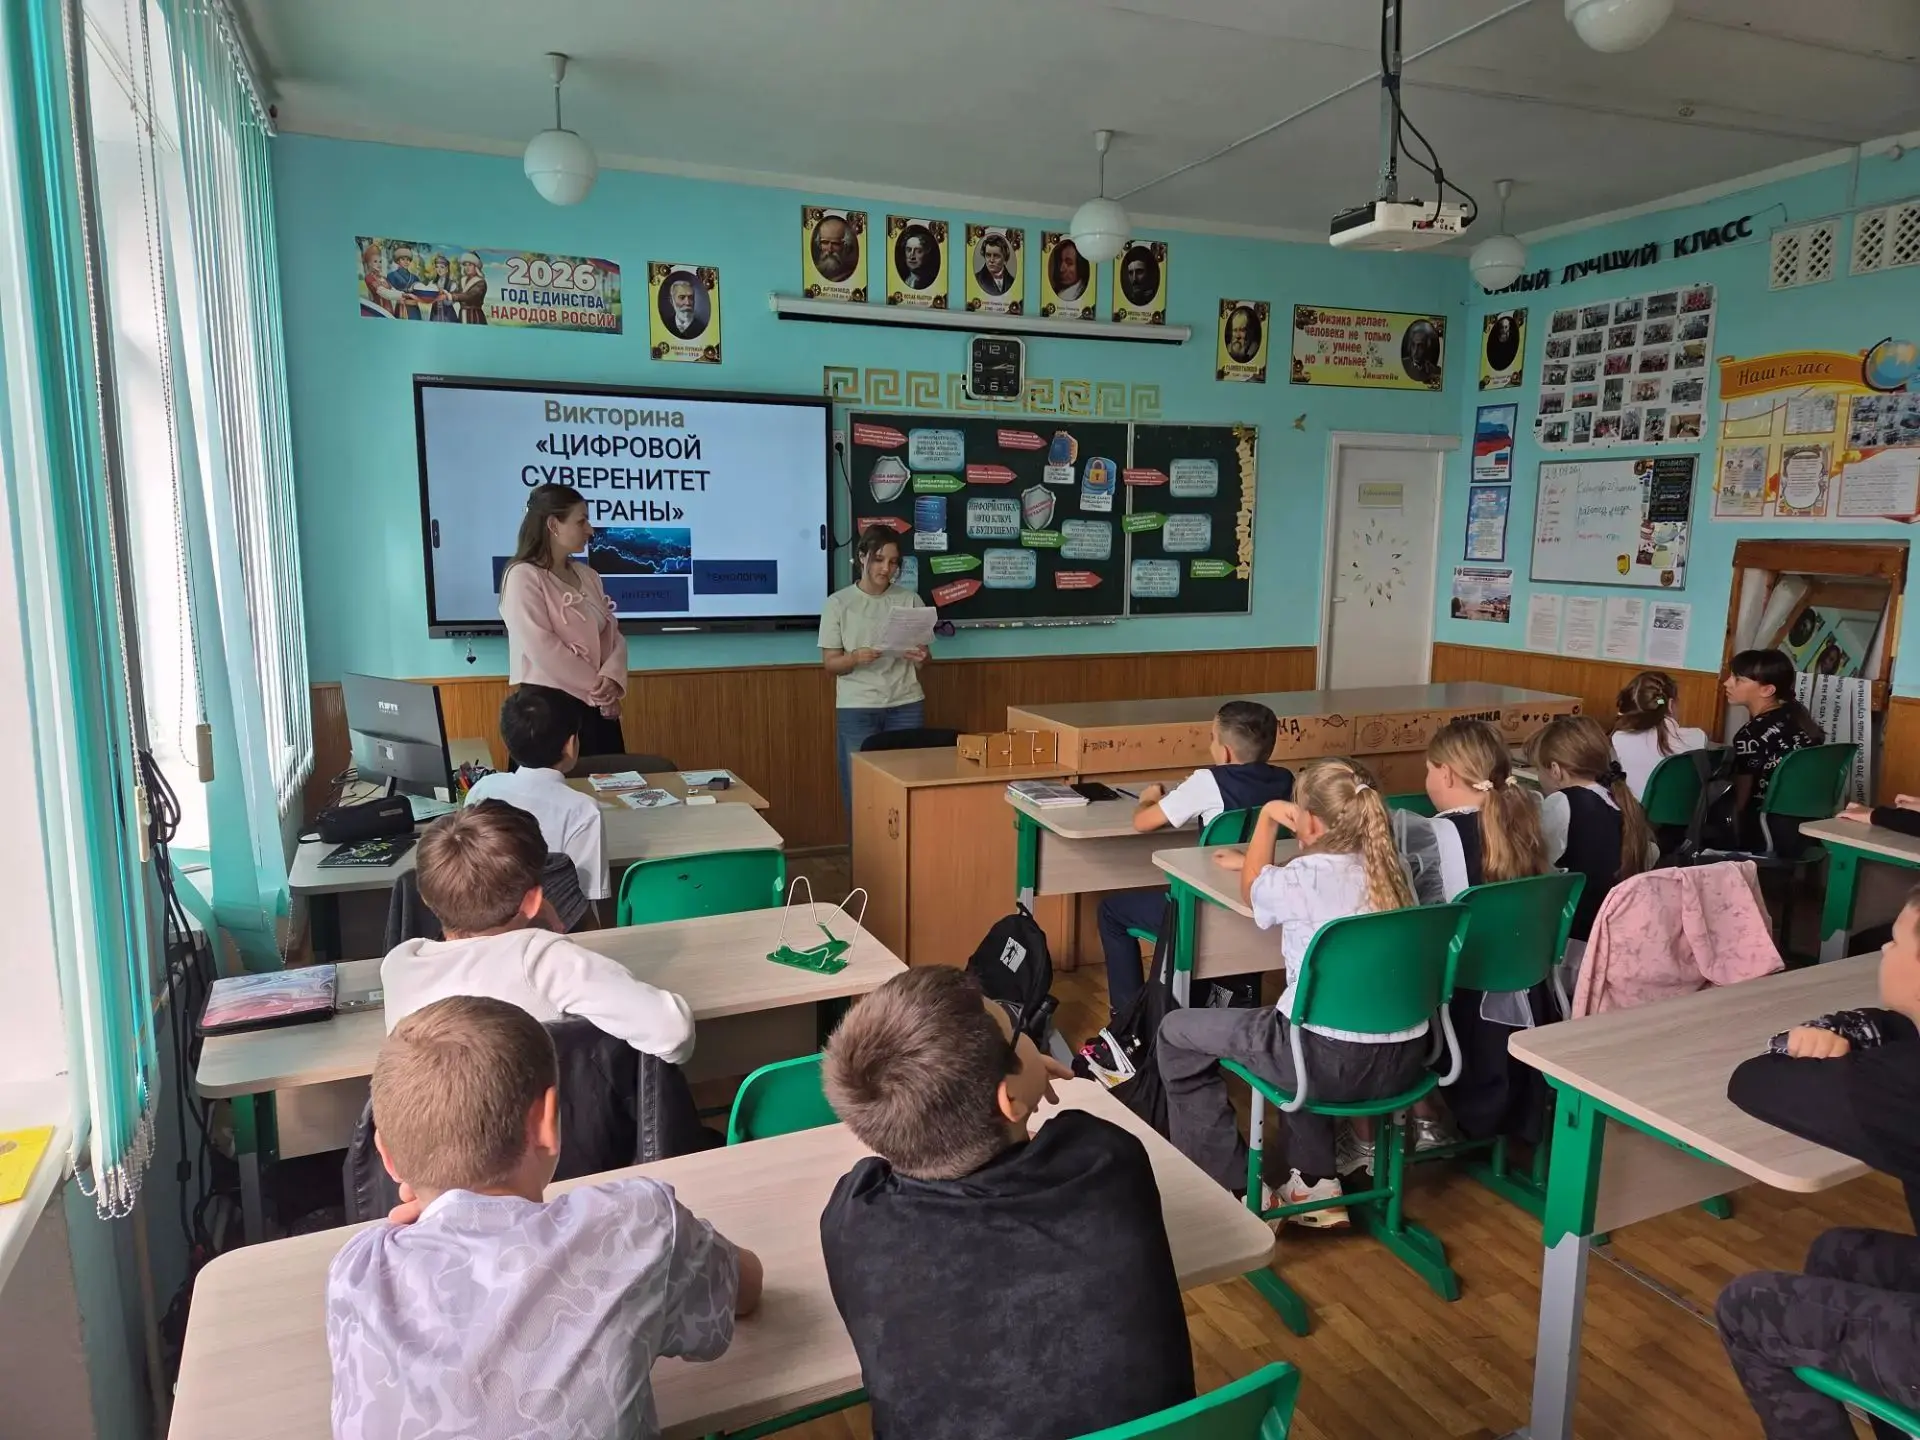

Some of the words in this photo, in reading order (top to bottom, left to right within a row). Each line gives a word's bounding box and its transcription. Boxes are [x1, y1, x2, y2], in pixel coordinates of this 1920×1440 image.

[1561, 242, 1659, 285] ЛУЧШИЙ
[1674, 215, 1753, 258] КЛАСС
[506, 257, 597, 291] 2026
[501, 288, 529, 305] ГОД
[533, 291, 604, 309] ЕДИНСТВА
[491, 305, 557, 323] НАРОДОВ
[561, 310, 616, 328] РОССИИ
[1318, 312, 1351, 327] Физика
[1305, 325, 1345, 339] человека
[1349, 331, 1359, 340] не
[1364, 332, 1392, 342] только
[1304, 354, 1316, 364] но
[1325, 355, 1331, 364] и
[1737, 367, 1776, 386] Наш
[1780, 363, 1833, 378] класс
[543, 399, 686, 431] Викторина
[535, 433, 702, 460] «ЦИФРОВОЙ
[520, 465, 710, 491] СУВЕРЕНИТЕТ
[586, 499, 685, 522] ТРАНЫ»
[1820, 695, 1827, 704] ты
[1821, 684, 1828, 693] на
[1857, 680, 1867, 719] ступенька
[1857, 720, 1865, 742] лишь
[1856, 765, 1865, 779] Это
[1855, 780, 1866, 803] удно?
